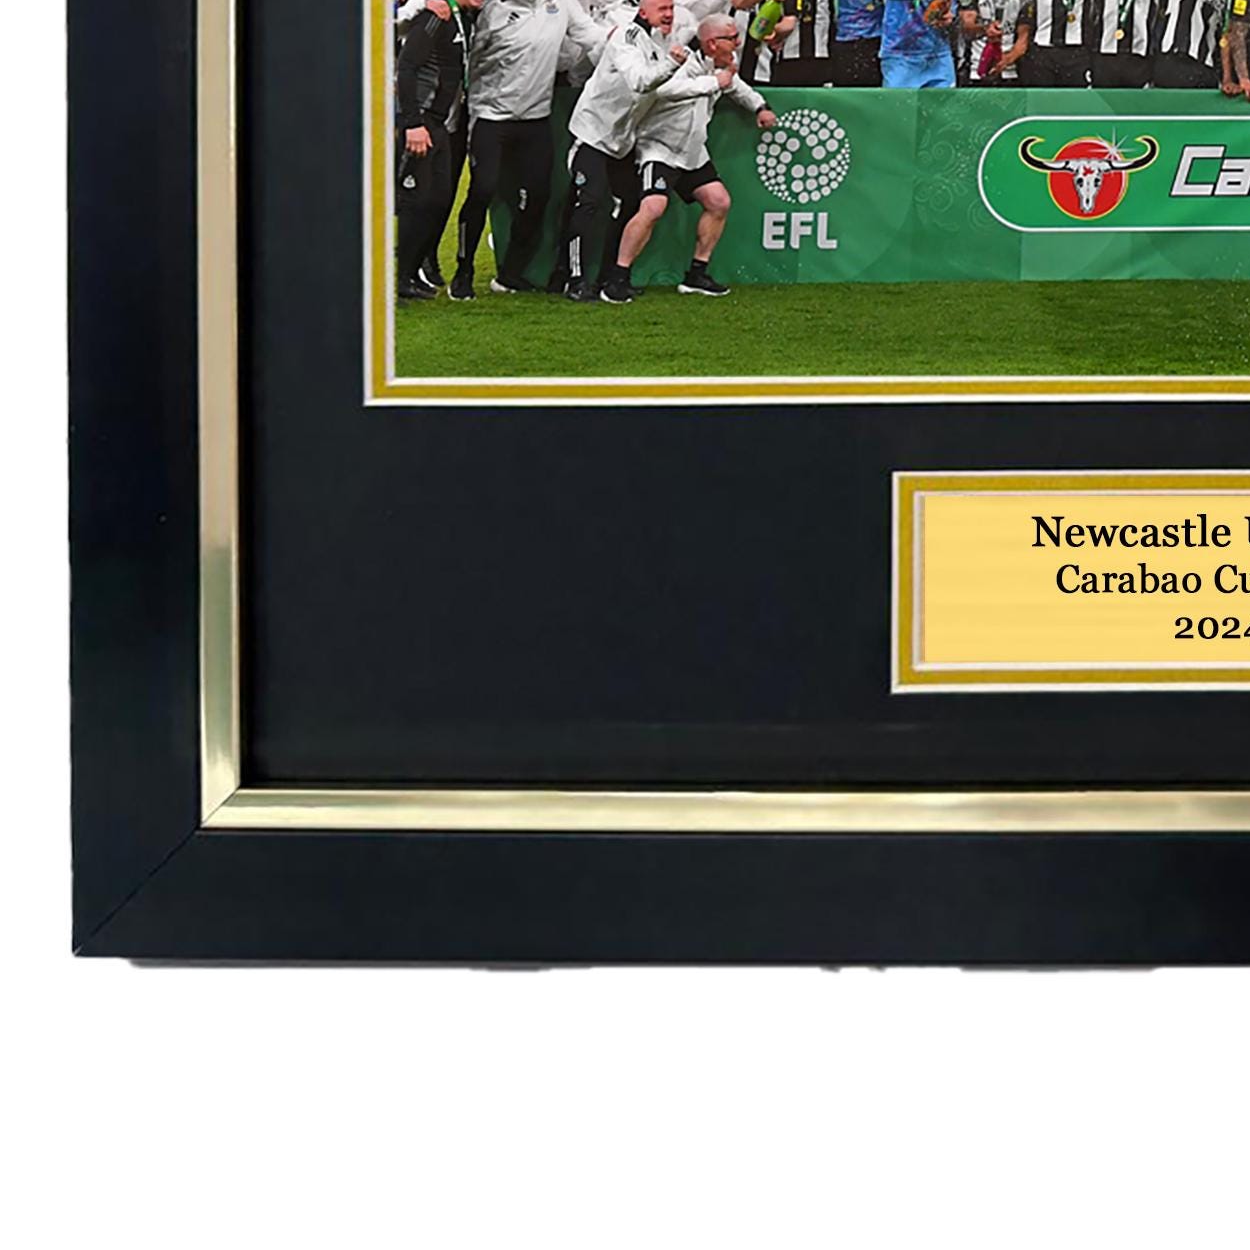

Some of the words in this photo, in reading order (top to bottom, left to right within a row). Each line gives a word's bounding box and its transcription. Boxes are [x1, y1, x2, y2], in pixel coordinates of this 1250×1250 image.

[762, 211, 838, 250] EFL
[1031, 513, 1232, 548] Newcastle
[1056, 562, 1202, 595] Carabao
